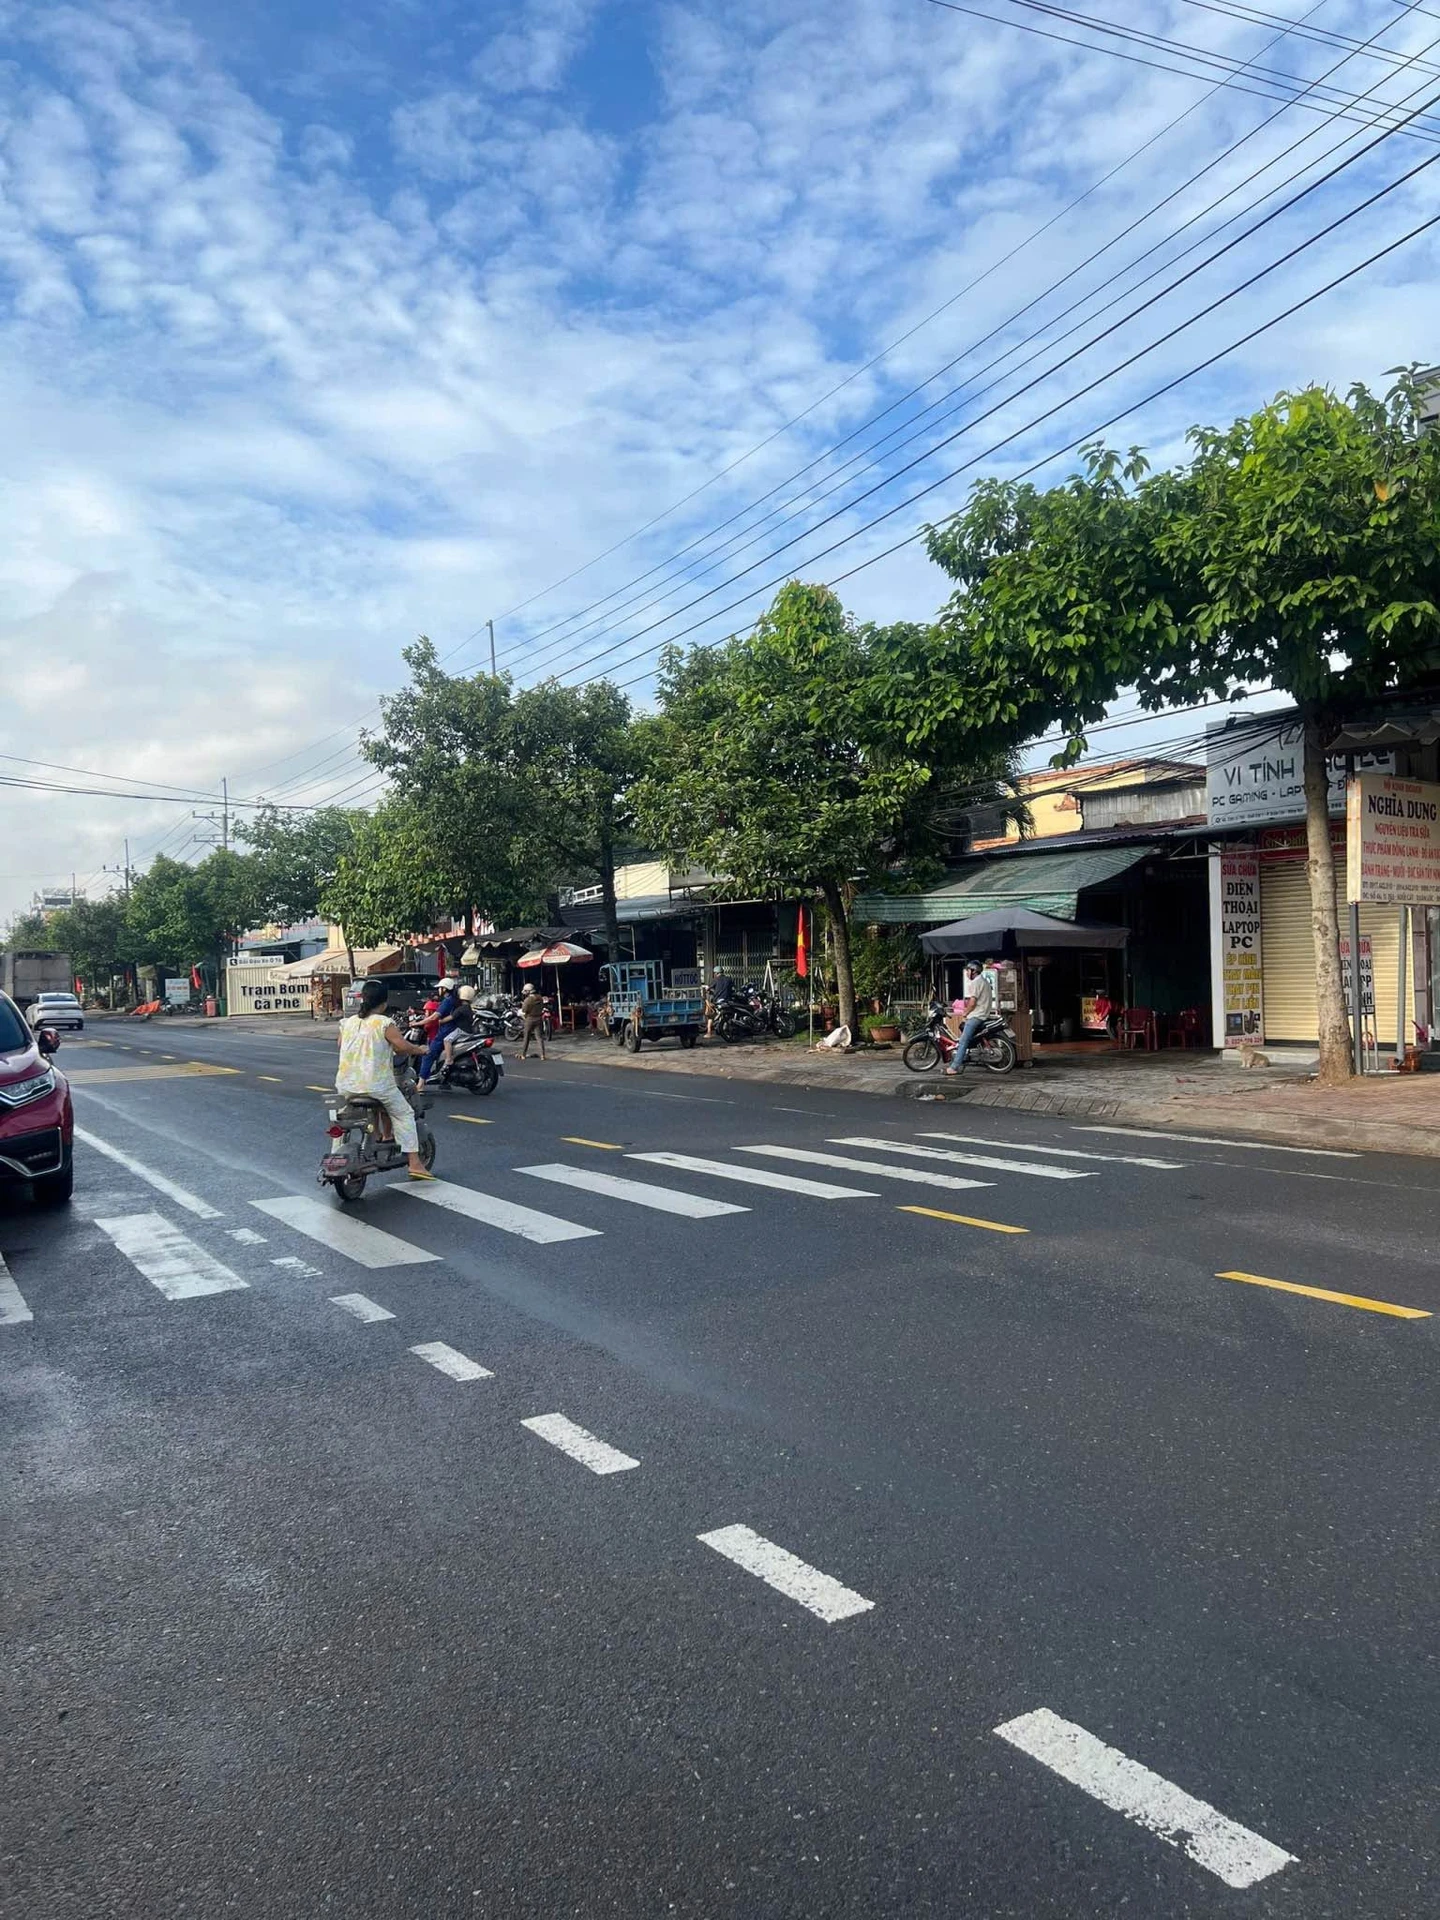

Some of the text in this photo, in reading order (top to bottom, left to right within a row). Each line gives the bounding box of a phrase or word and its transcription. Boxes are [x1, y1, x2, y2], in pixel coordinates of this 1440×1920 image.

[1224, 755, 1294, 786] VI TÍNH
[1212, 794, 1225, 806] PC
[1229, 789, 1267, 805] GAMING
[1407, 800, 1437, 821] DUNG
[1227, 879, 1253, 899] ĐIỆN
[1223, 901, 1258, 917] THOẠI
[1222, 921, 1260, 933] LAPTOP
[1230, 936, 1253, 948] PC
